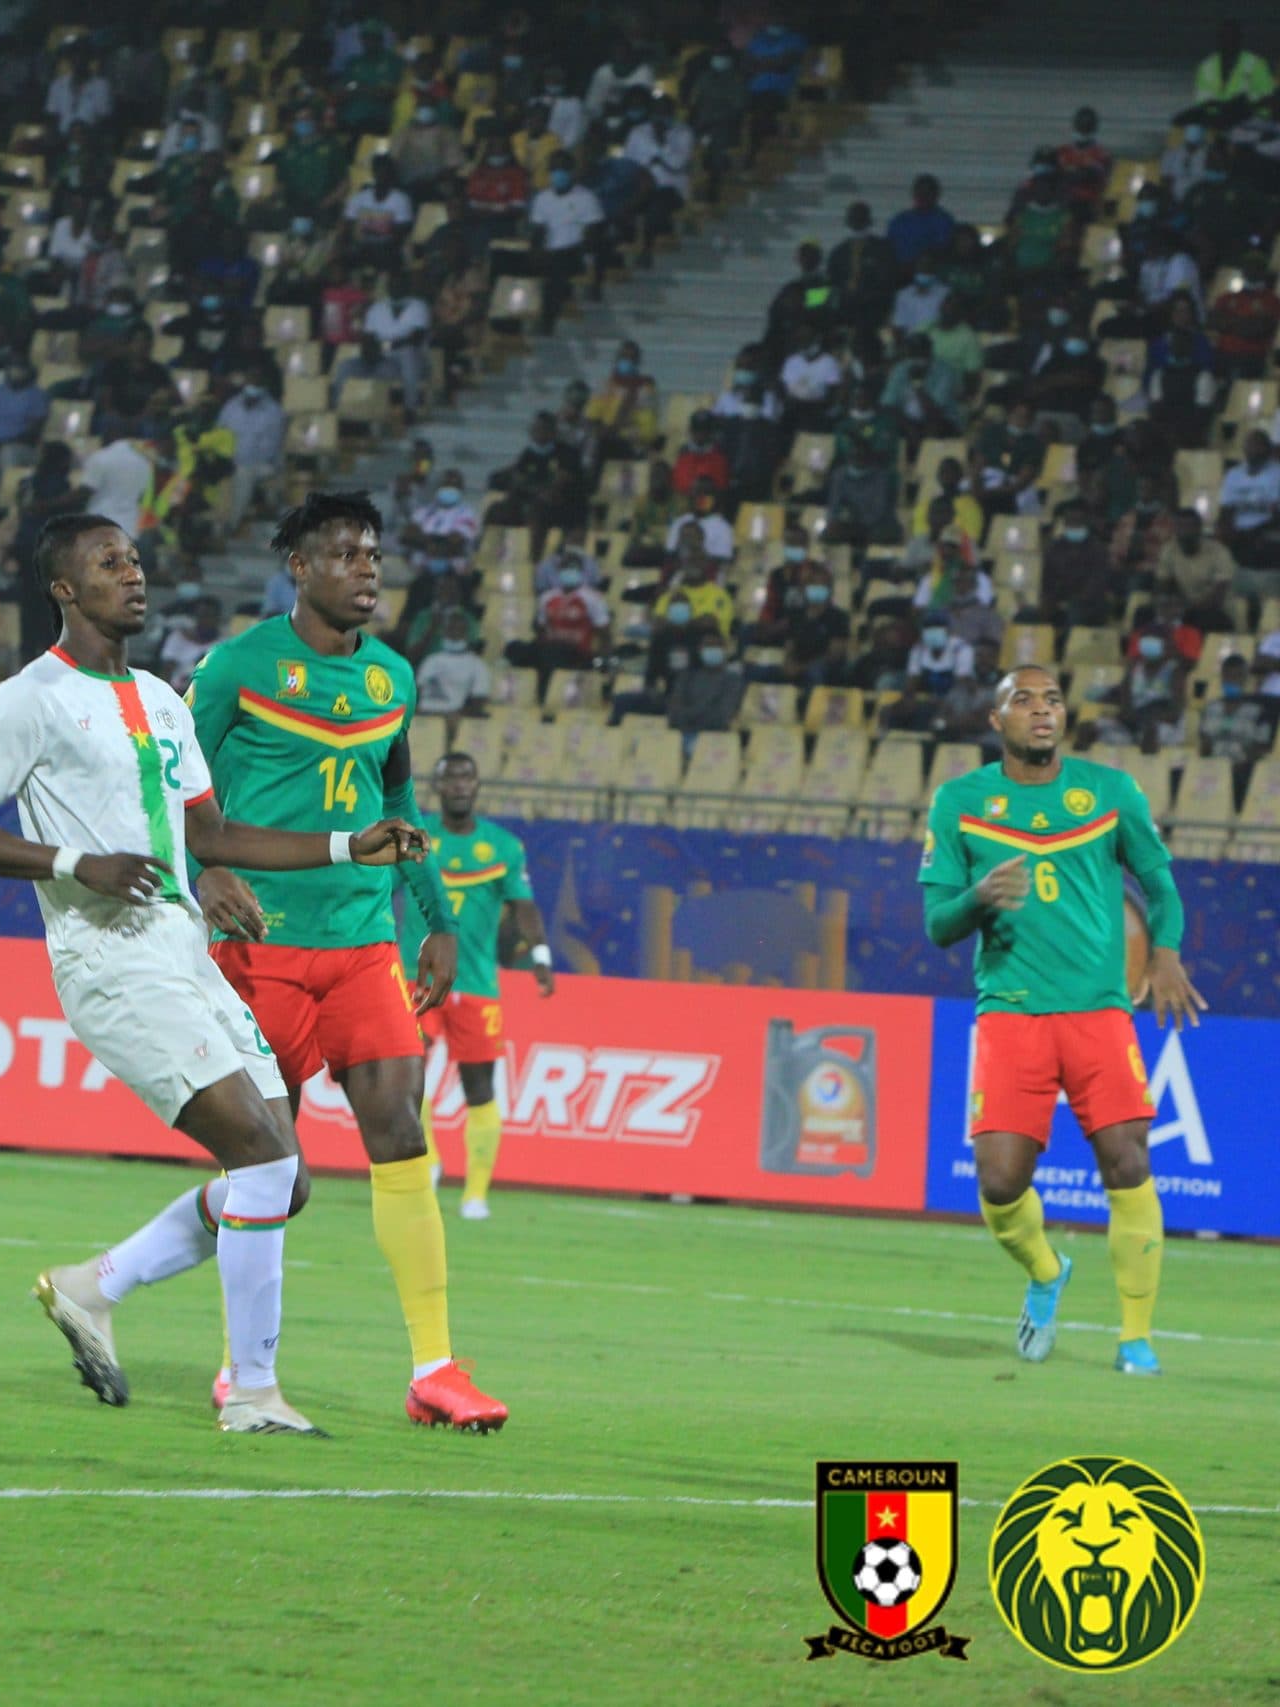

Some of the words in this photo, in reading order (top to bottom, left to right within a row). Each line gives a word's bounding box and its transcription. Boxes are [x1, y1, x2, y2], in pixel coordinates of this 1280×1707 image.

[159, 739, 183, 789] 2
[319, 757, 358, 813] 14
[1035, 861, 1059, 902] 6
